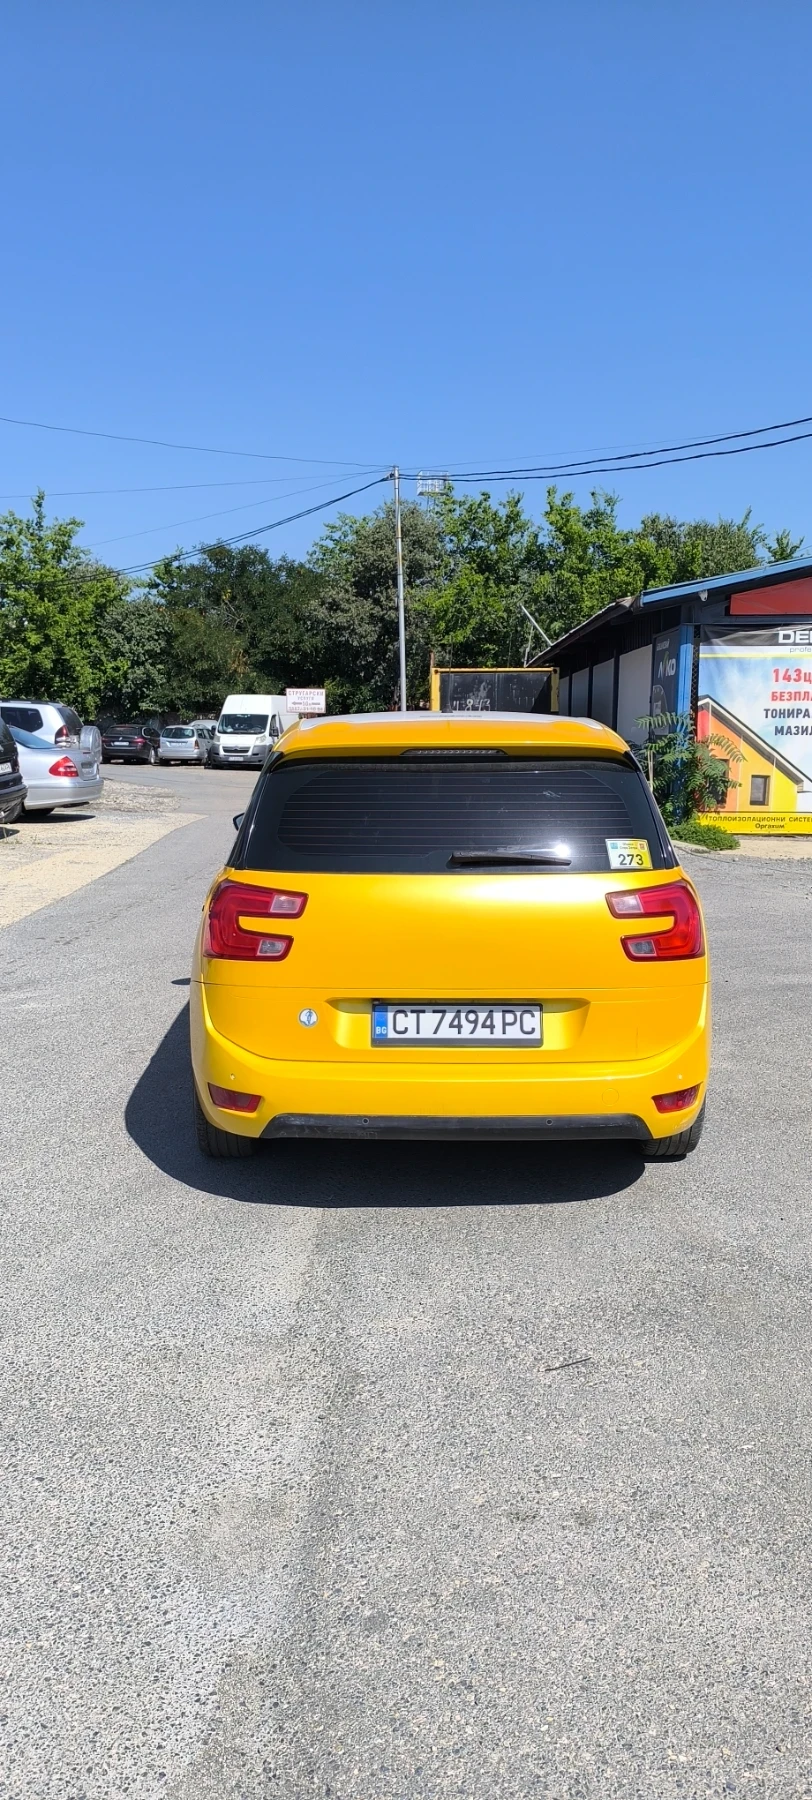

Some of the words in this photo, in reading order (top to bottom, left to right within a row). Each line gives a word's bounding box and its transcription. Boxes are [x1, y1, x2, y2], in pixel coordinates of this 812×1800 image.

[778, 630, 812, 644] DE
[771, 691, 812, 702] БЕЗПЛ
[763, 708, 812, 719] ТОНИРА
[618, 853, 644, 866] 273
[375, 1026, 387, 1034] BG
